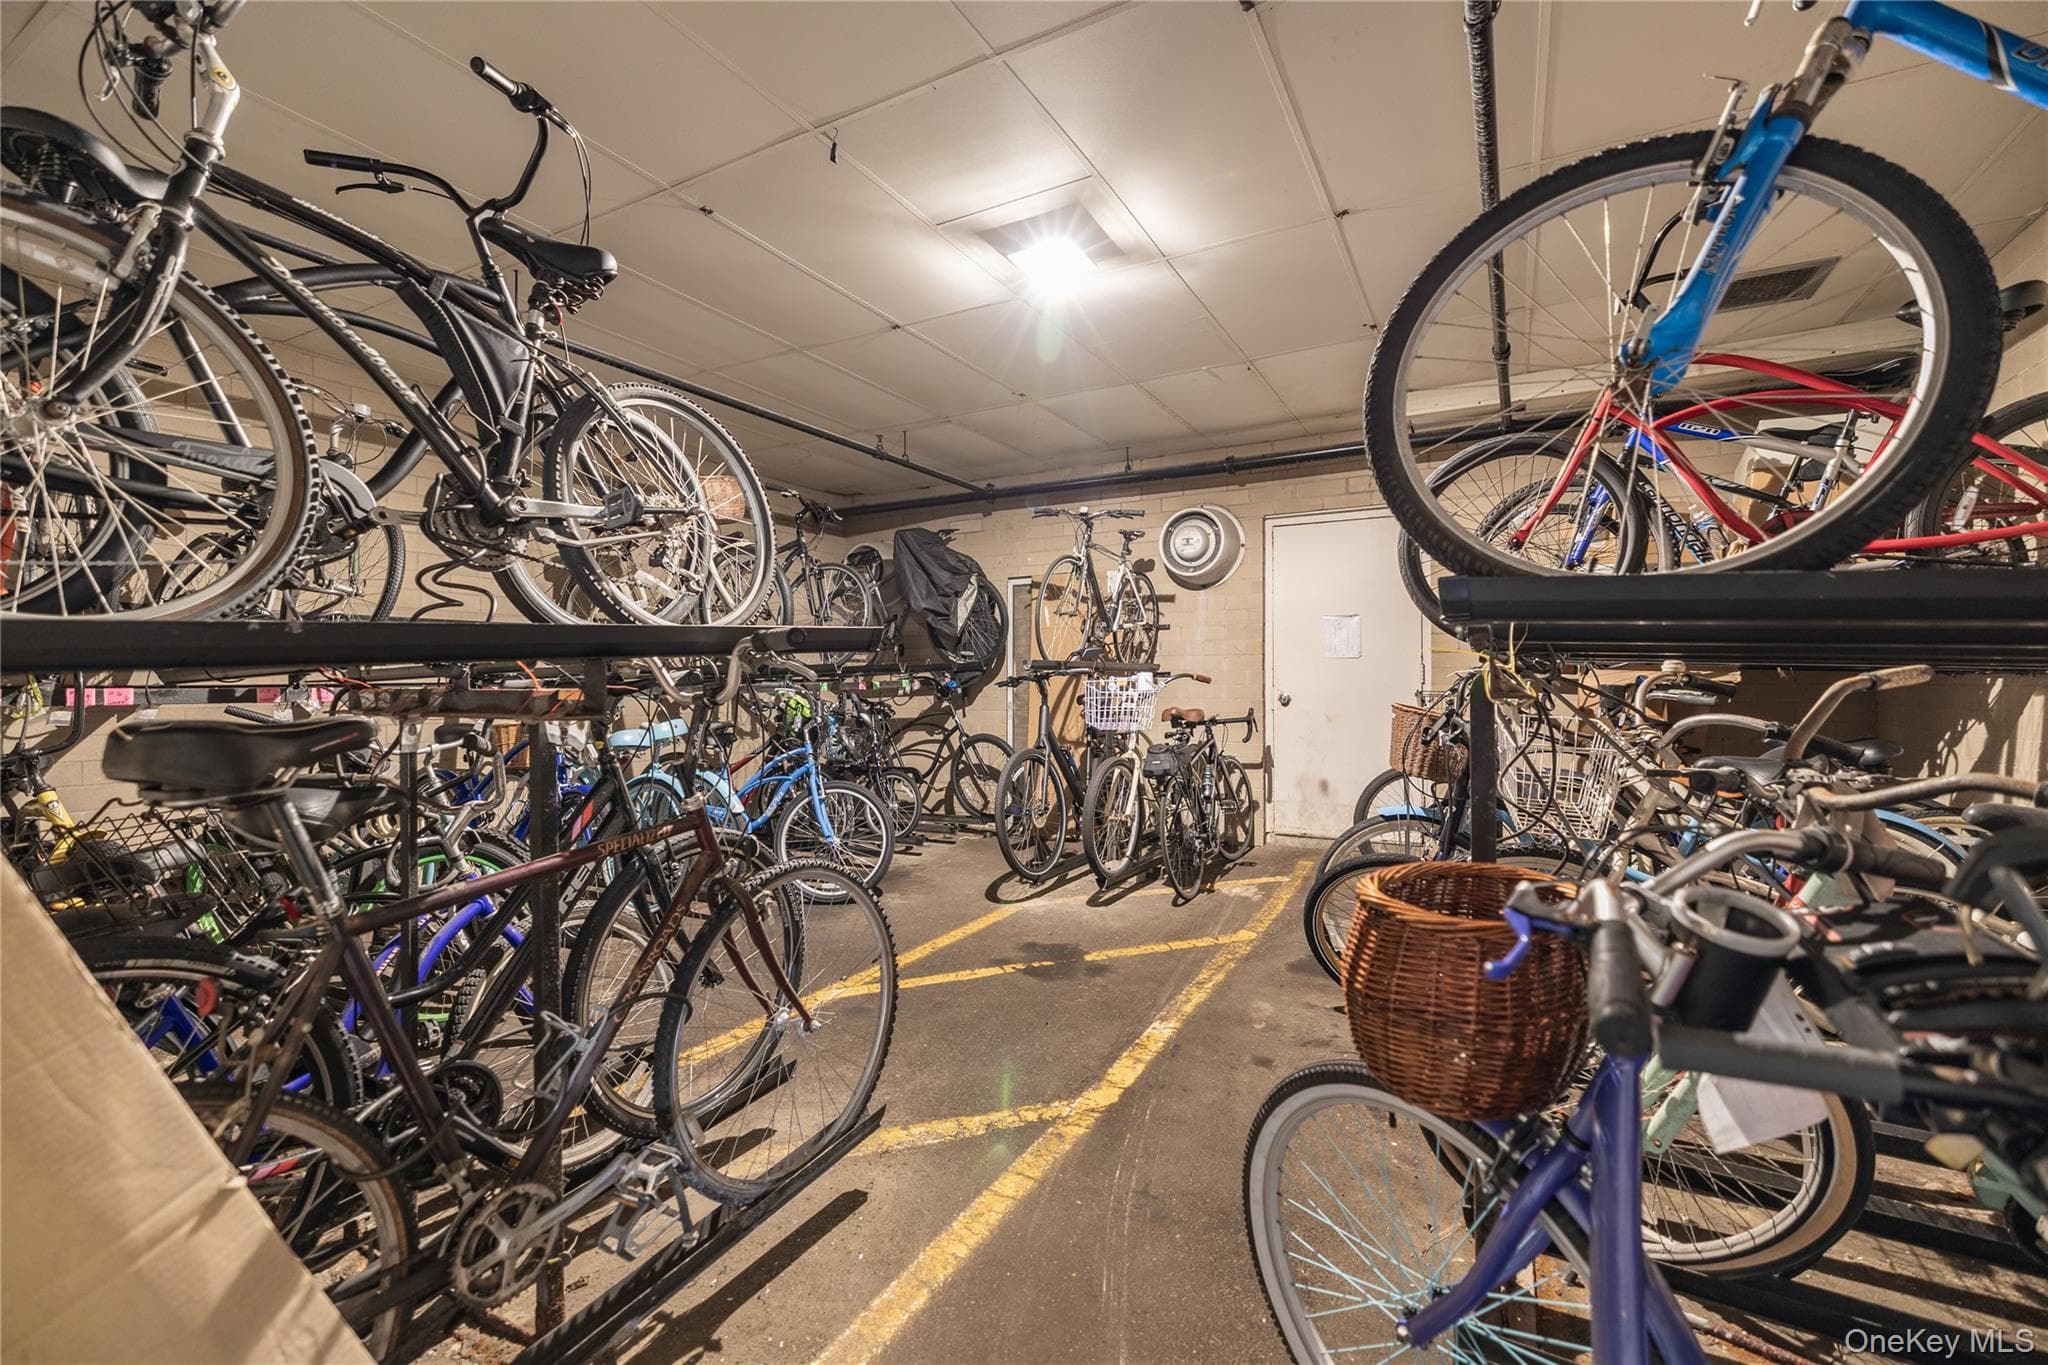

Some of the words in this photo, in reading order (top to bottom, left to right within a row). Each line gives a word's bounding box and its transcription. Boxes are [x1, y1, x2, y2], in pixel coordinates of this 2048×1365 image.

[259, 256, 429, 415] Diamondback
[1636, 481, 1714, 562] cannondal
[598, 823, 675, 859] SPECIALIZED
[559, 860, 596, 915] RE
[783, 881, 801, 922] ONTRAGER
